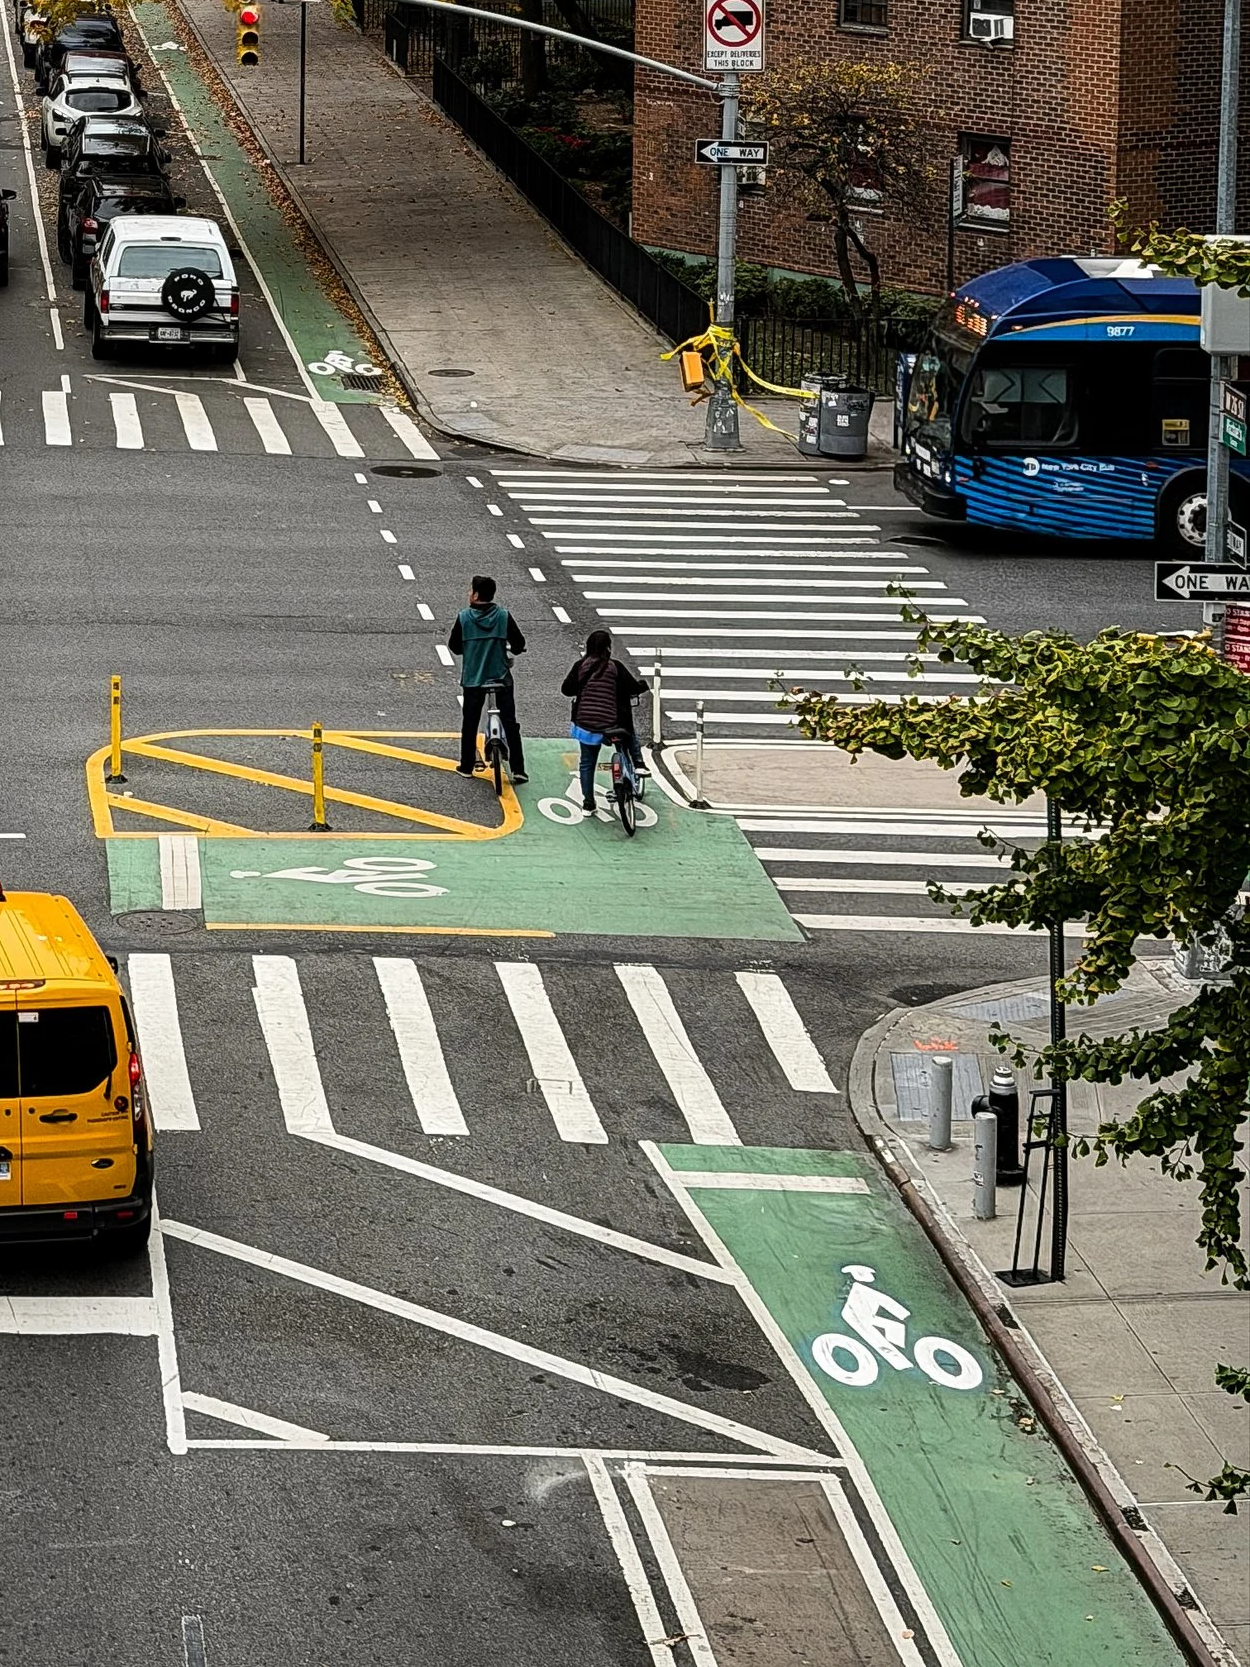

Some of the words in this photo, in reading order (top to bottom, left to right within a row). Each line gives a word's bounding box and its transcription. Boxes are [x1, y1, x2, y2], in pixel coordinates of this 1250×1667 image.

[707, 50, 728, 58] EXCEPT
[730, 50, 761, 58] DELIVERIES
[714, 59, 729, 67] THIS
[731, 59, 754, 67] BLOCK
[710, 147, 729, 157] ONE
[739, 149, 760, 157] WAY
[174, 274, 203, 285] FORD
[168, 295, 206, 313] BRONCO
[1106, 326, 1134, 337] 9877
[1175, 575, 1209, 590] ONE
